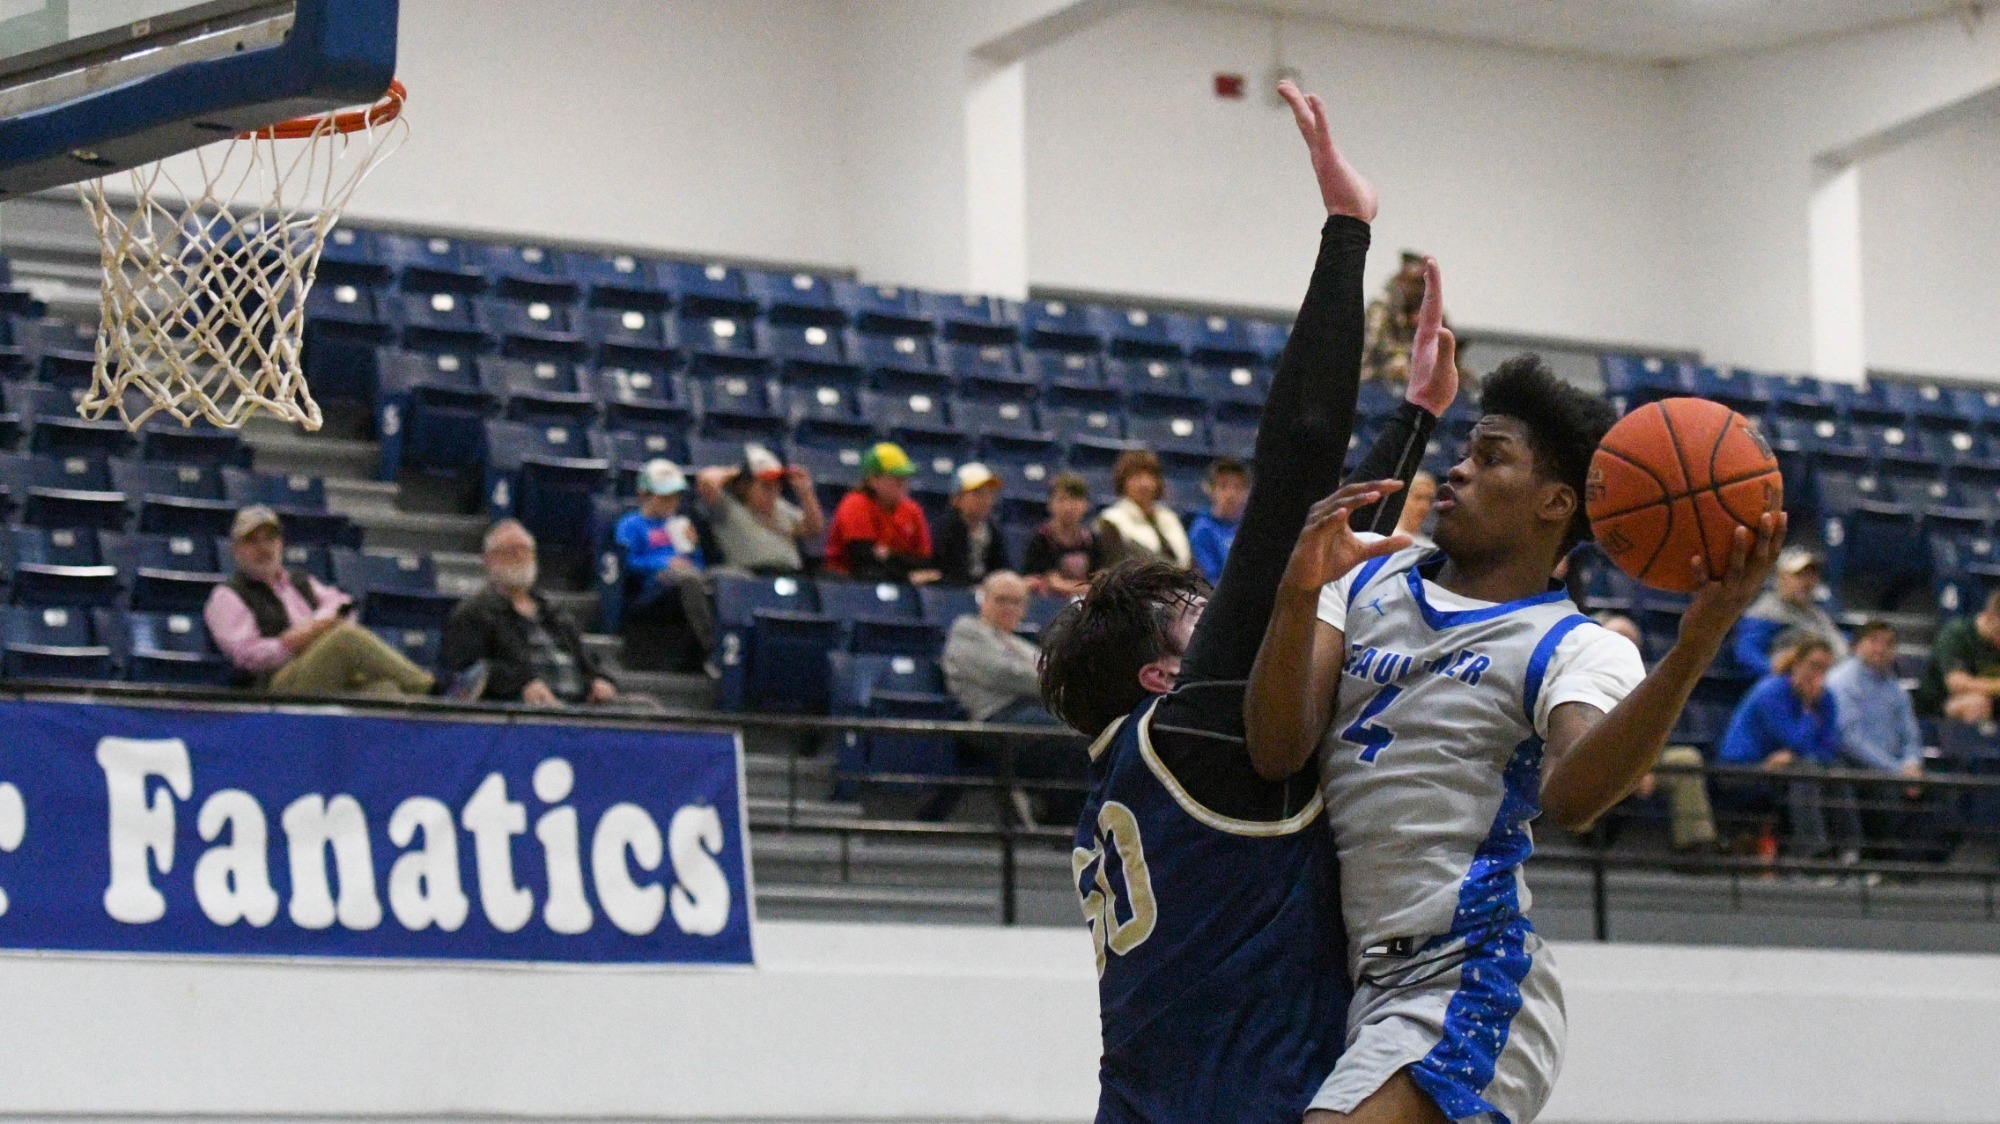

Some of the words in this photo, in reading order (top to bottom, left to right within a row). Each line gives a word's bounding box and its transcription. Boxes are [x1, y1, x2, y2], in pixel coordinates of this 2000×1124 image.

[1341, 683, 1403, 763] 4
[97, 736, 730, 936] Fanatics
[1396, 940, 1402, 951] L
